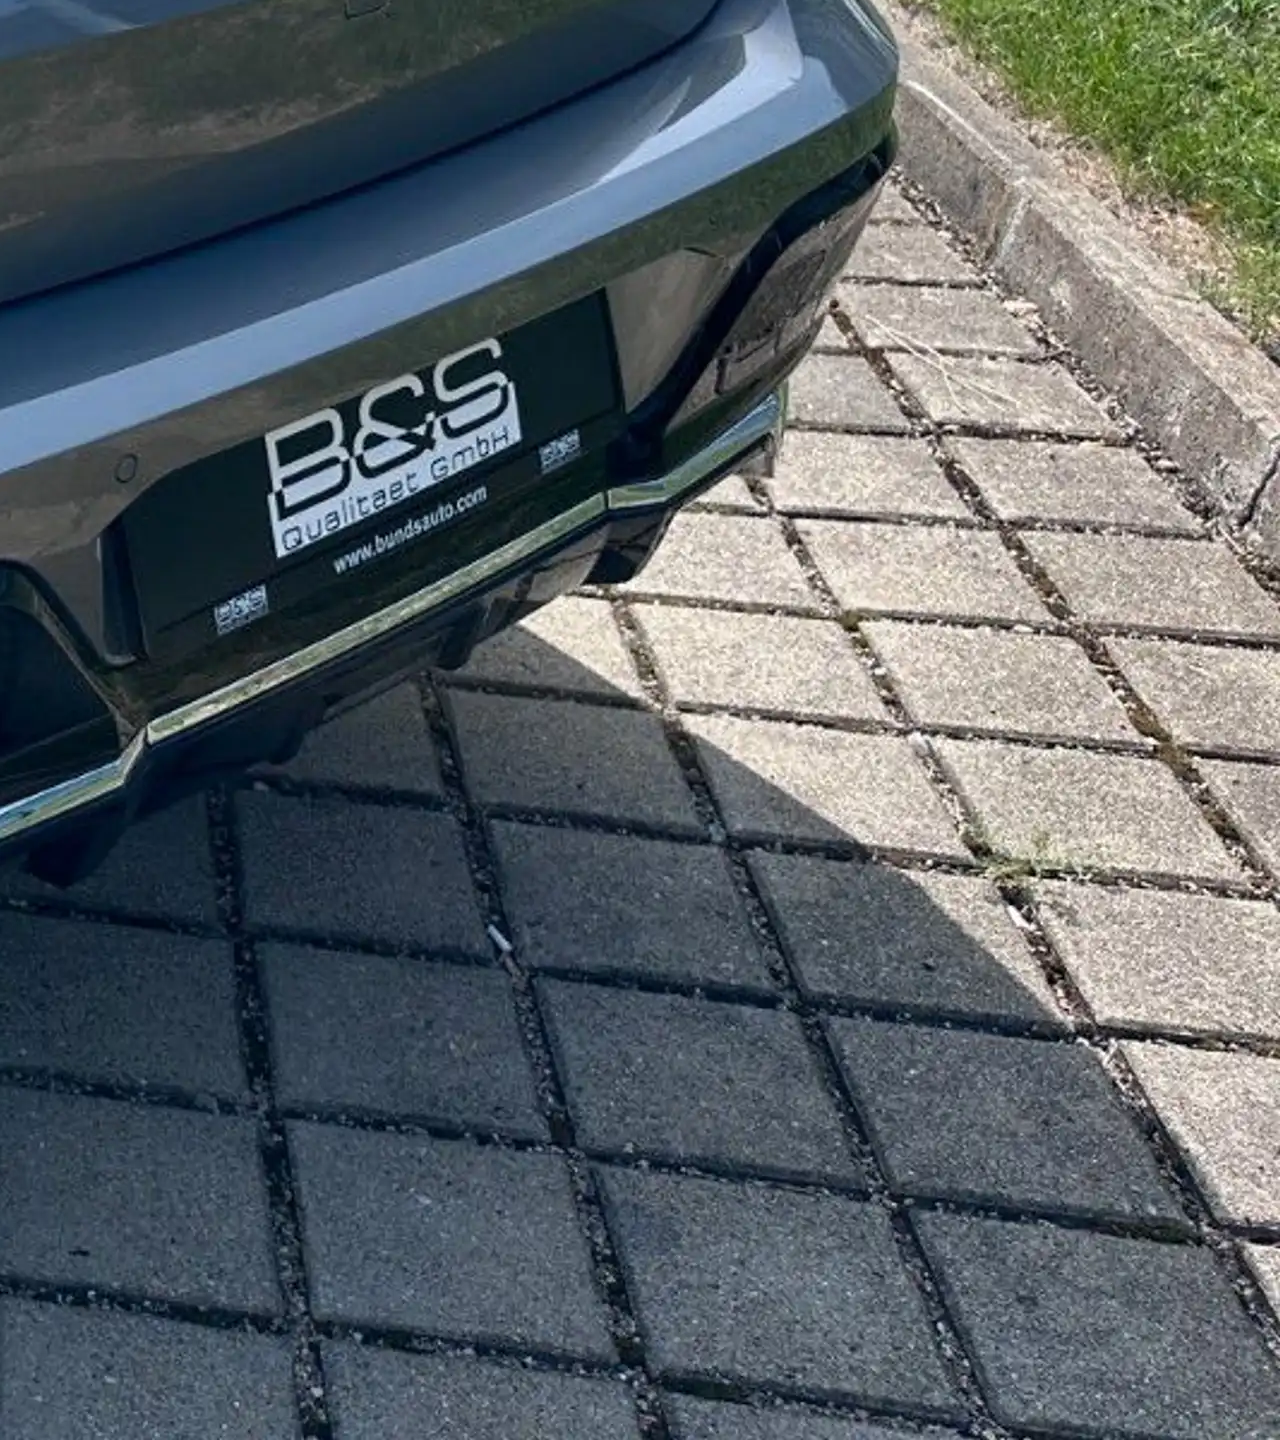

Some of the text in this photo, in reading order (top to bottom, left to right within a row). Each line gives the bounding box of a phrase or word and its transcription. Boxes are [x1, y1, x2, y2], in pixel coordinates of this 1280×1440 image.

[265, 338, 510, 522] B&S
[281, 426, 510, 551] Qualitaet GmbH
[333, 485, 488, 574] www.bundsauto.com
